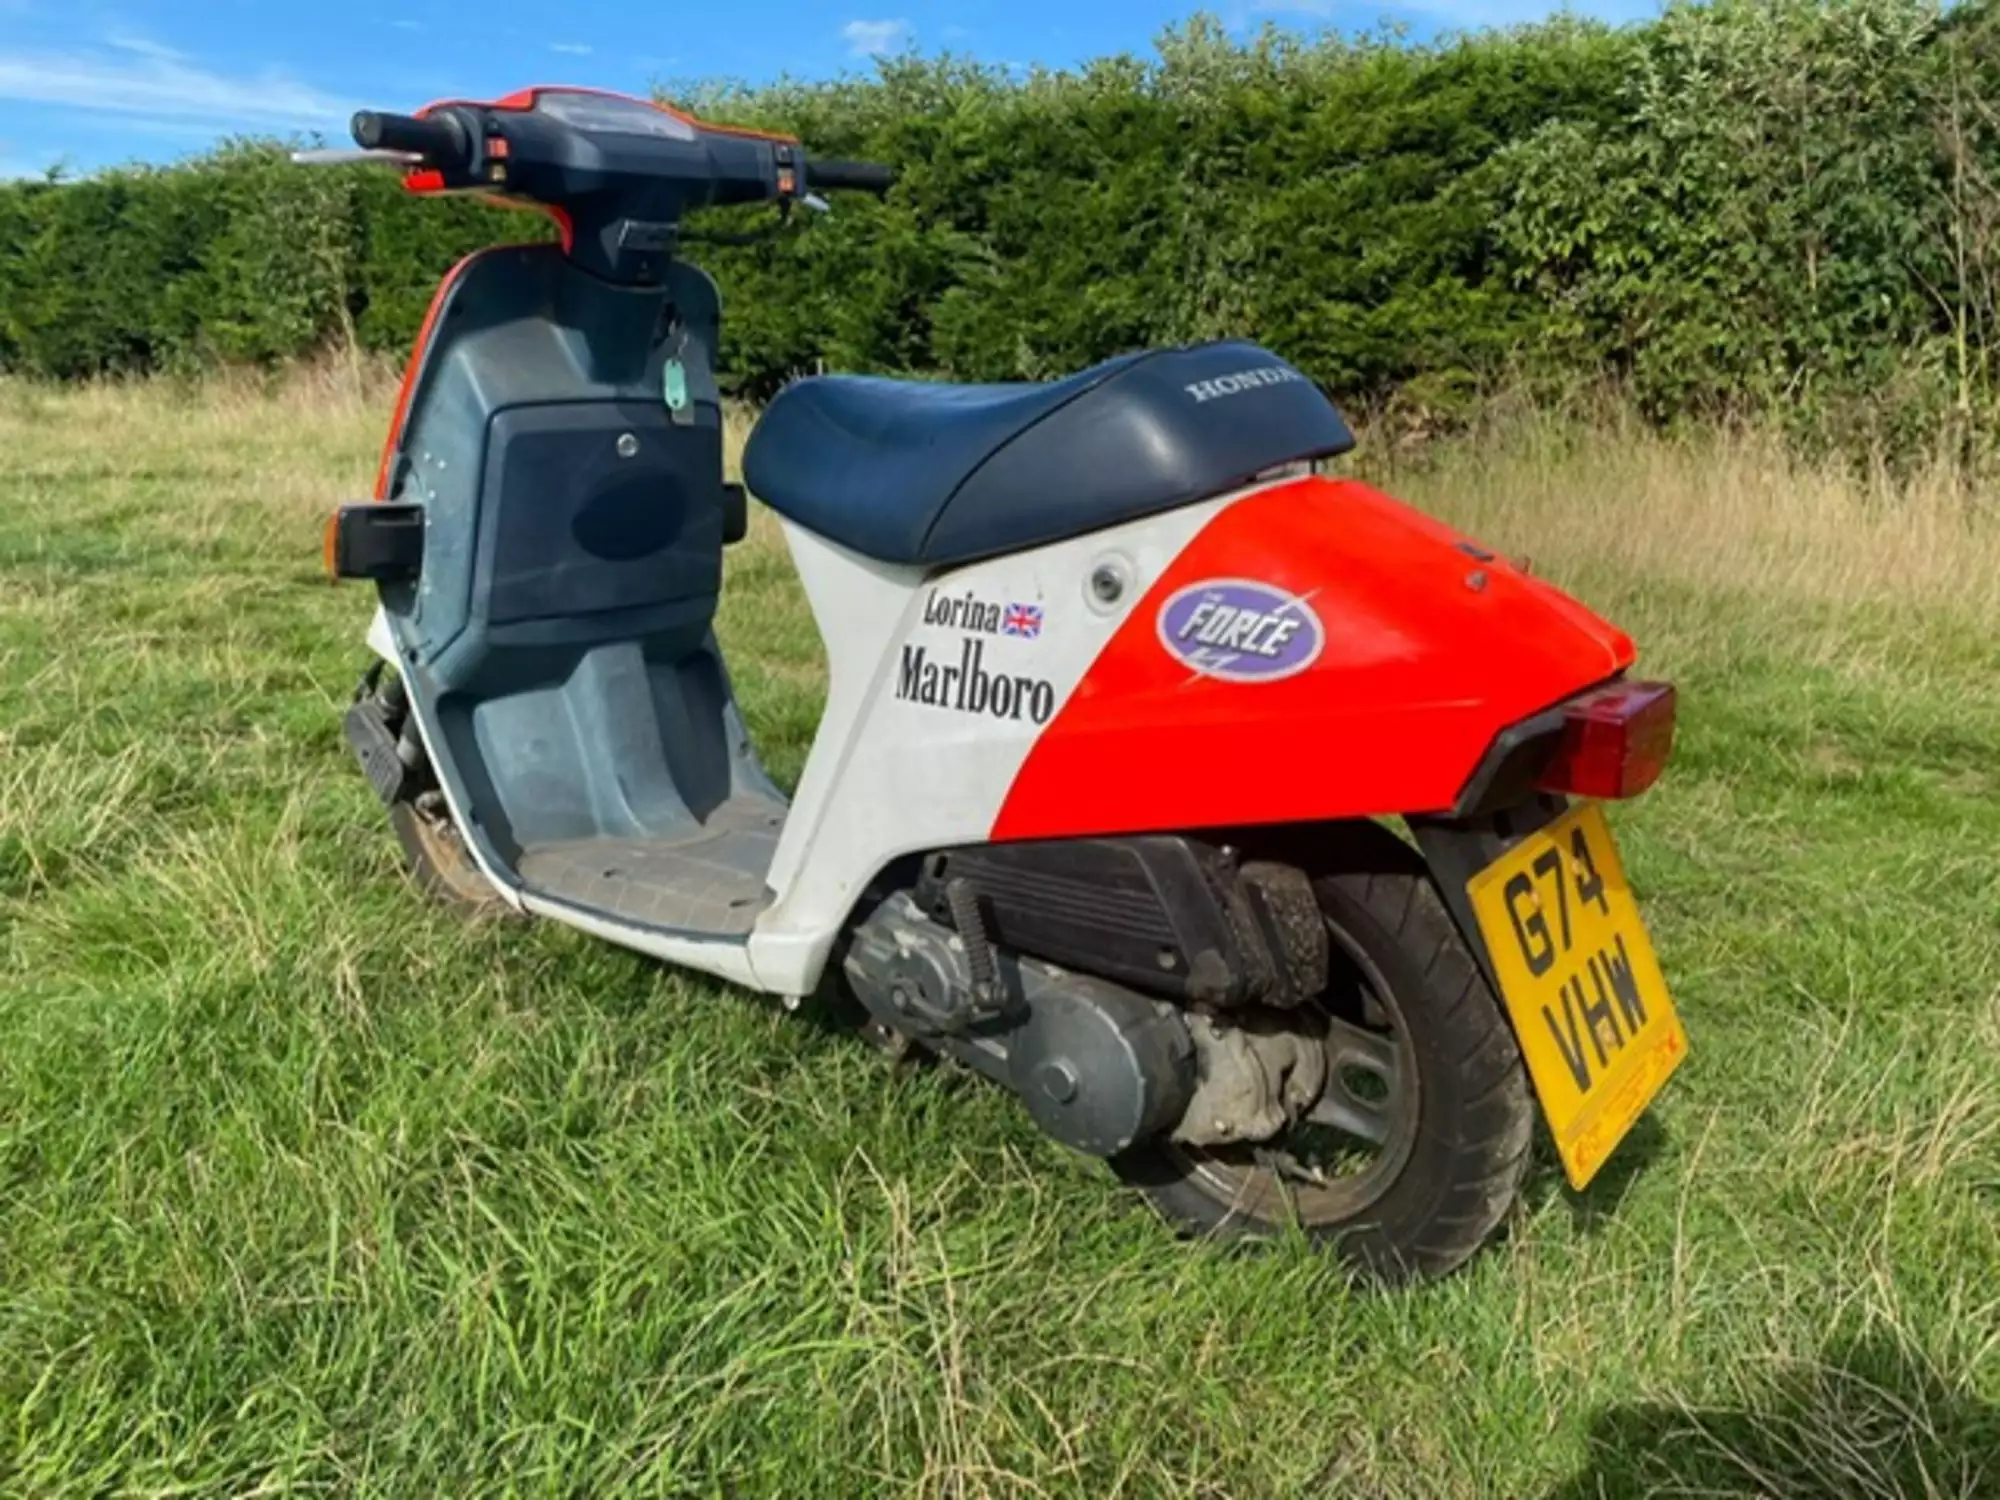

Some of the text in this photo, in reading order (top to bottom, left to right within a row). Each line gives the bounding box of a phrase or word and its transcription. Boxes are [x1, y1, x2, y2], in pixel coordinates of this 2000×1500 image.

[1185, 365, 1299, 402] HONDA
[924, 587, 1001, 634] Lorina
[1178, 602, 1300, 656] FORCE
[896, 637, 1054, 725] Marlboro
[1504, 827, 1609, 977] G74
[1542, 933, 1648, 1094] VHW
